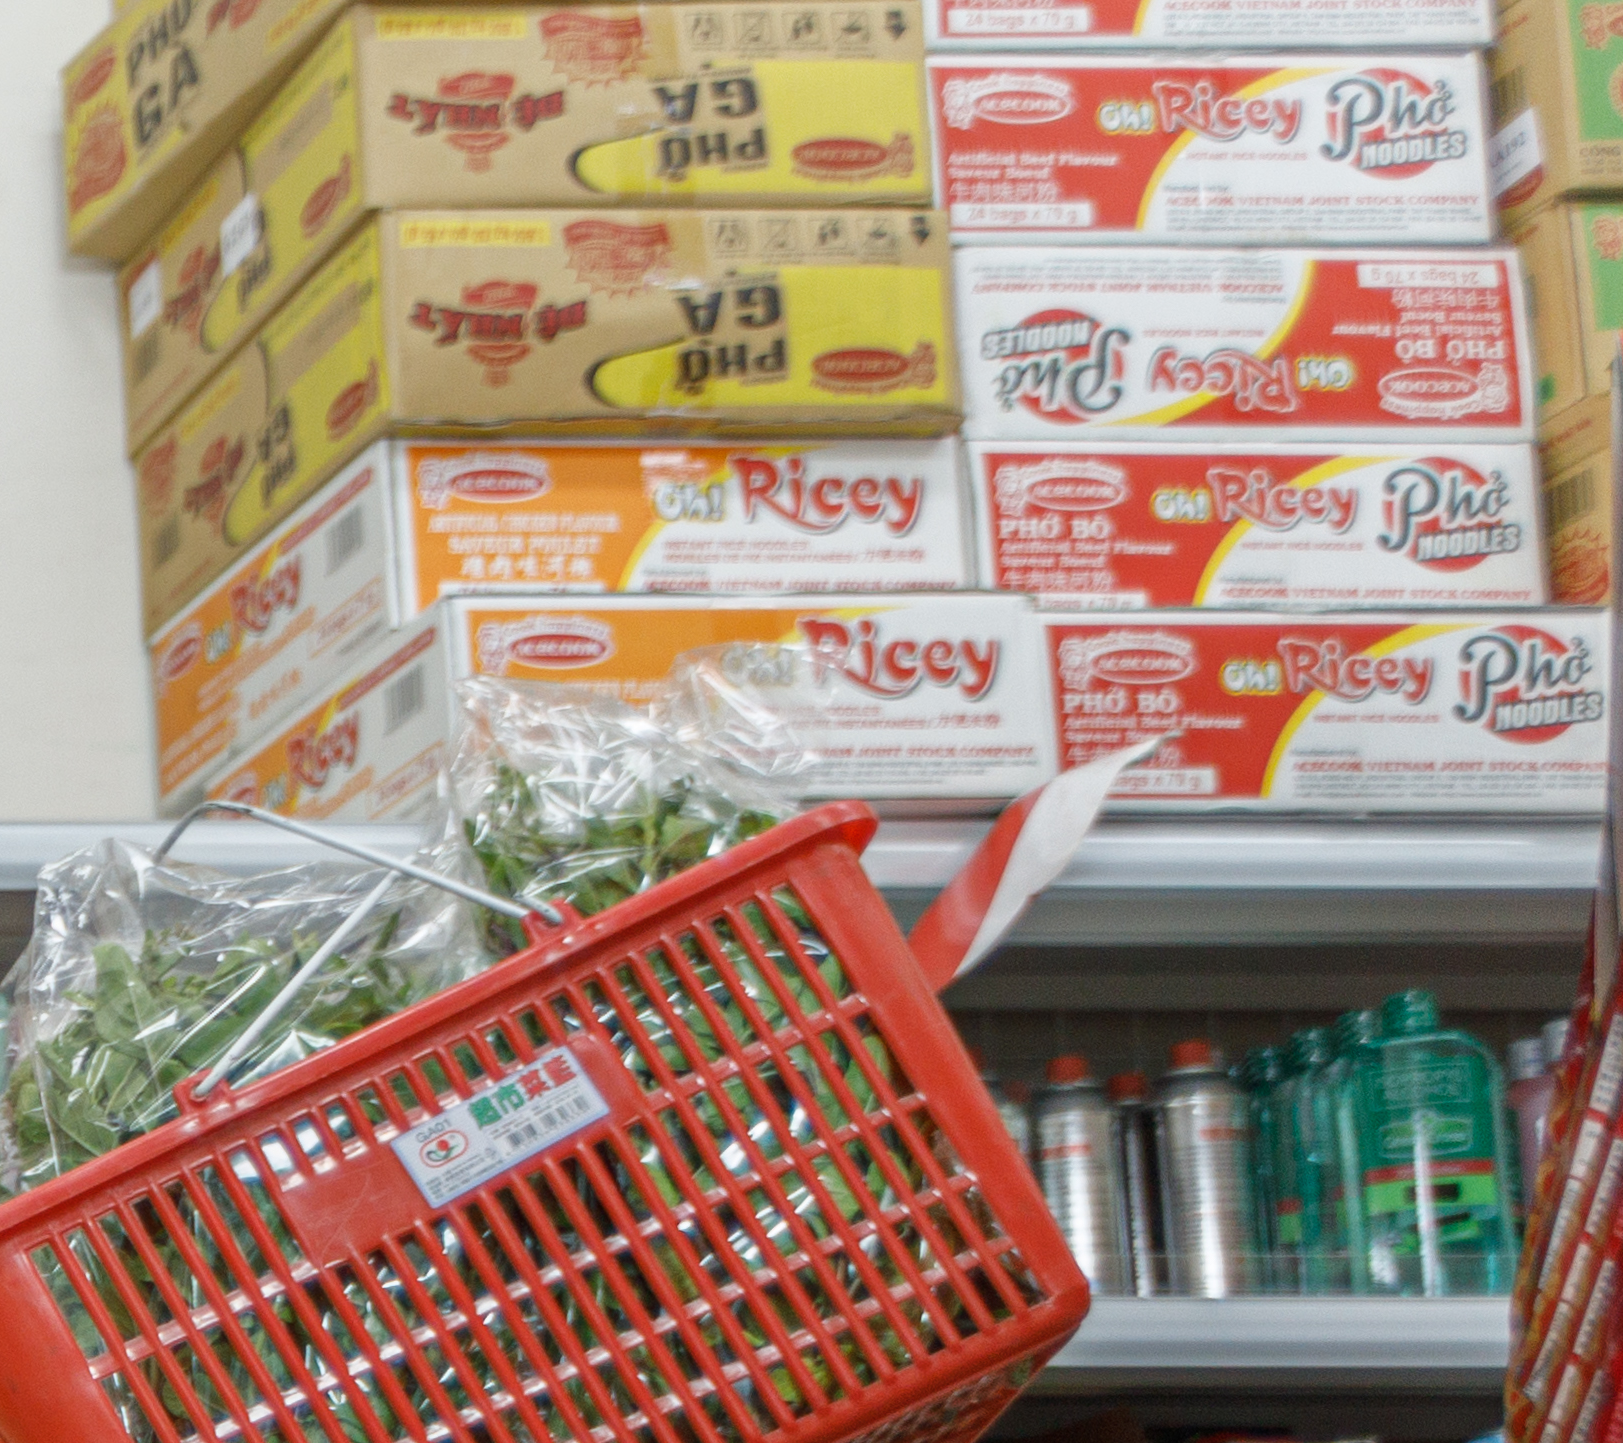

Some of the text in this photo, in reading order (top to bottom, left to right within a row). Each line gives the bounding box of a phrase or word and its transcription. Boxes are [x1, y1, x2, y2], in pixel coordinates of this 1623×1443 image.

[1152, 81, 1302, 144] Ricey
[1320, 77, 1456, 161] Phở
[1360, 131, 1466, 169] NOODLES
[730, 453, 924, 538] Ricey
[1206, 469, 1359, 534] Ricey
[1379, 466, 1511, 551] Phở
[1416, 525, 1521, 560] NOODLES
[798, 615, 1000, 702] Ricey
[1277, 638, 1435, 704] Ricey
[1453, 635, 1593, 724] Phở
[1492, 693, 1604, 734] NOODLES
